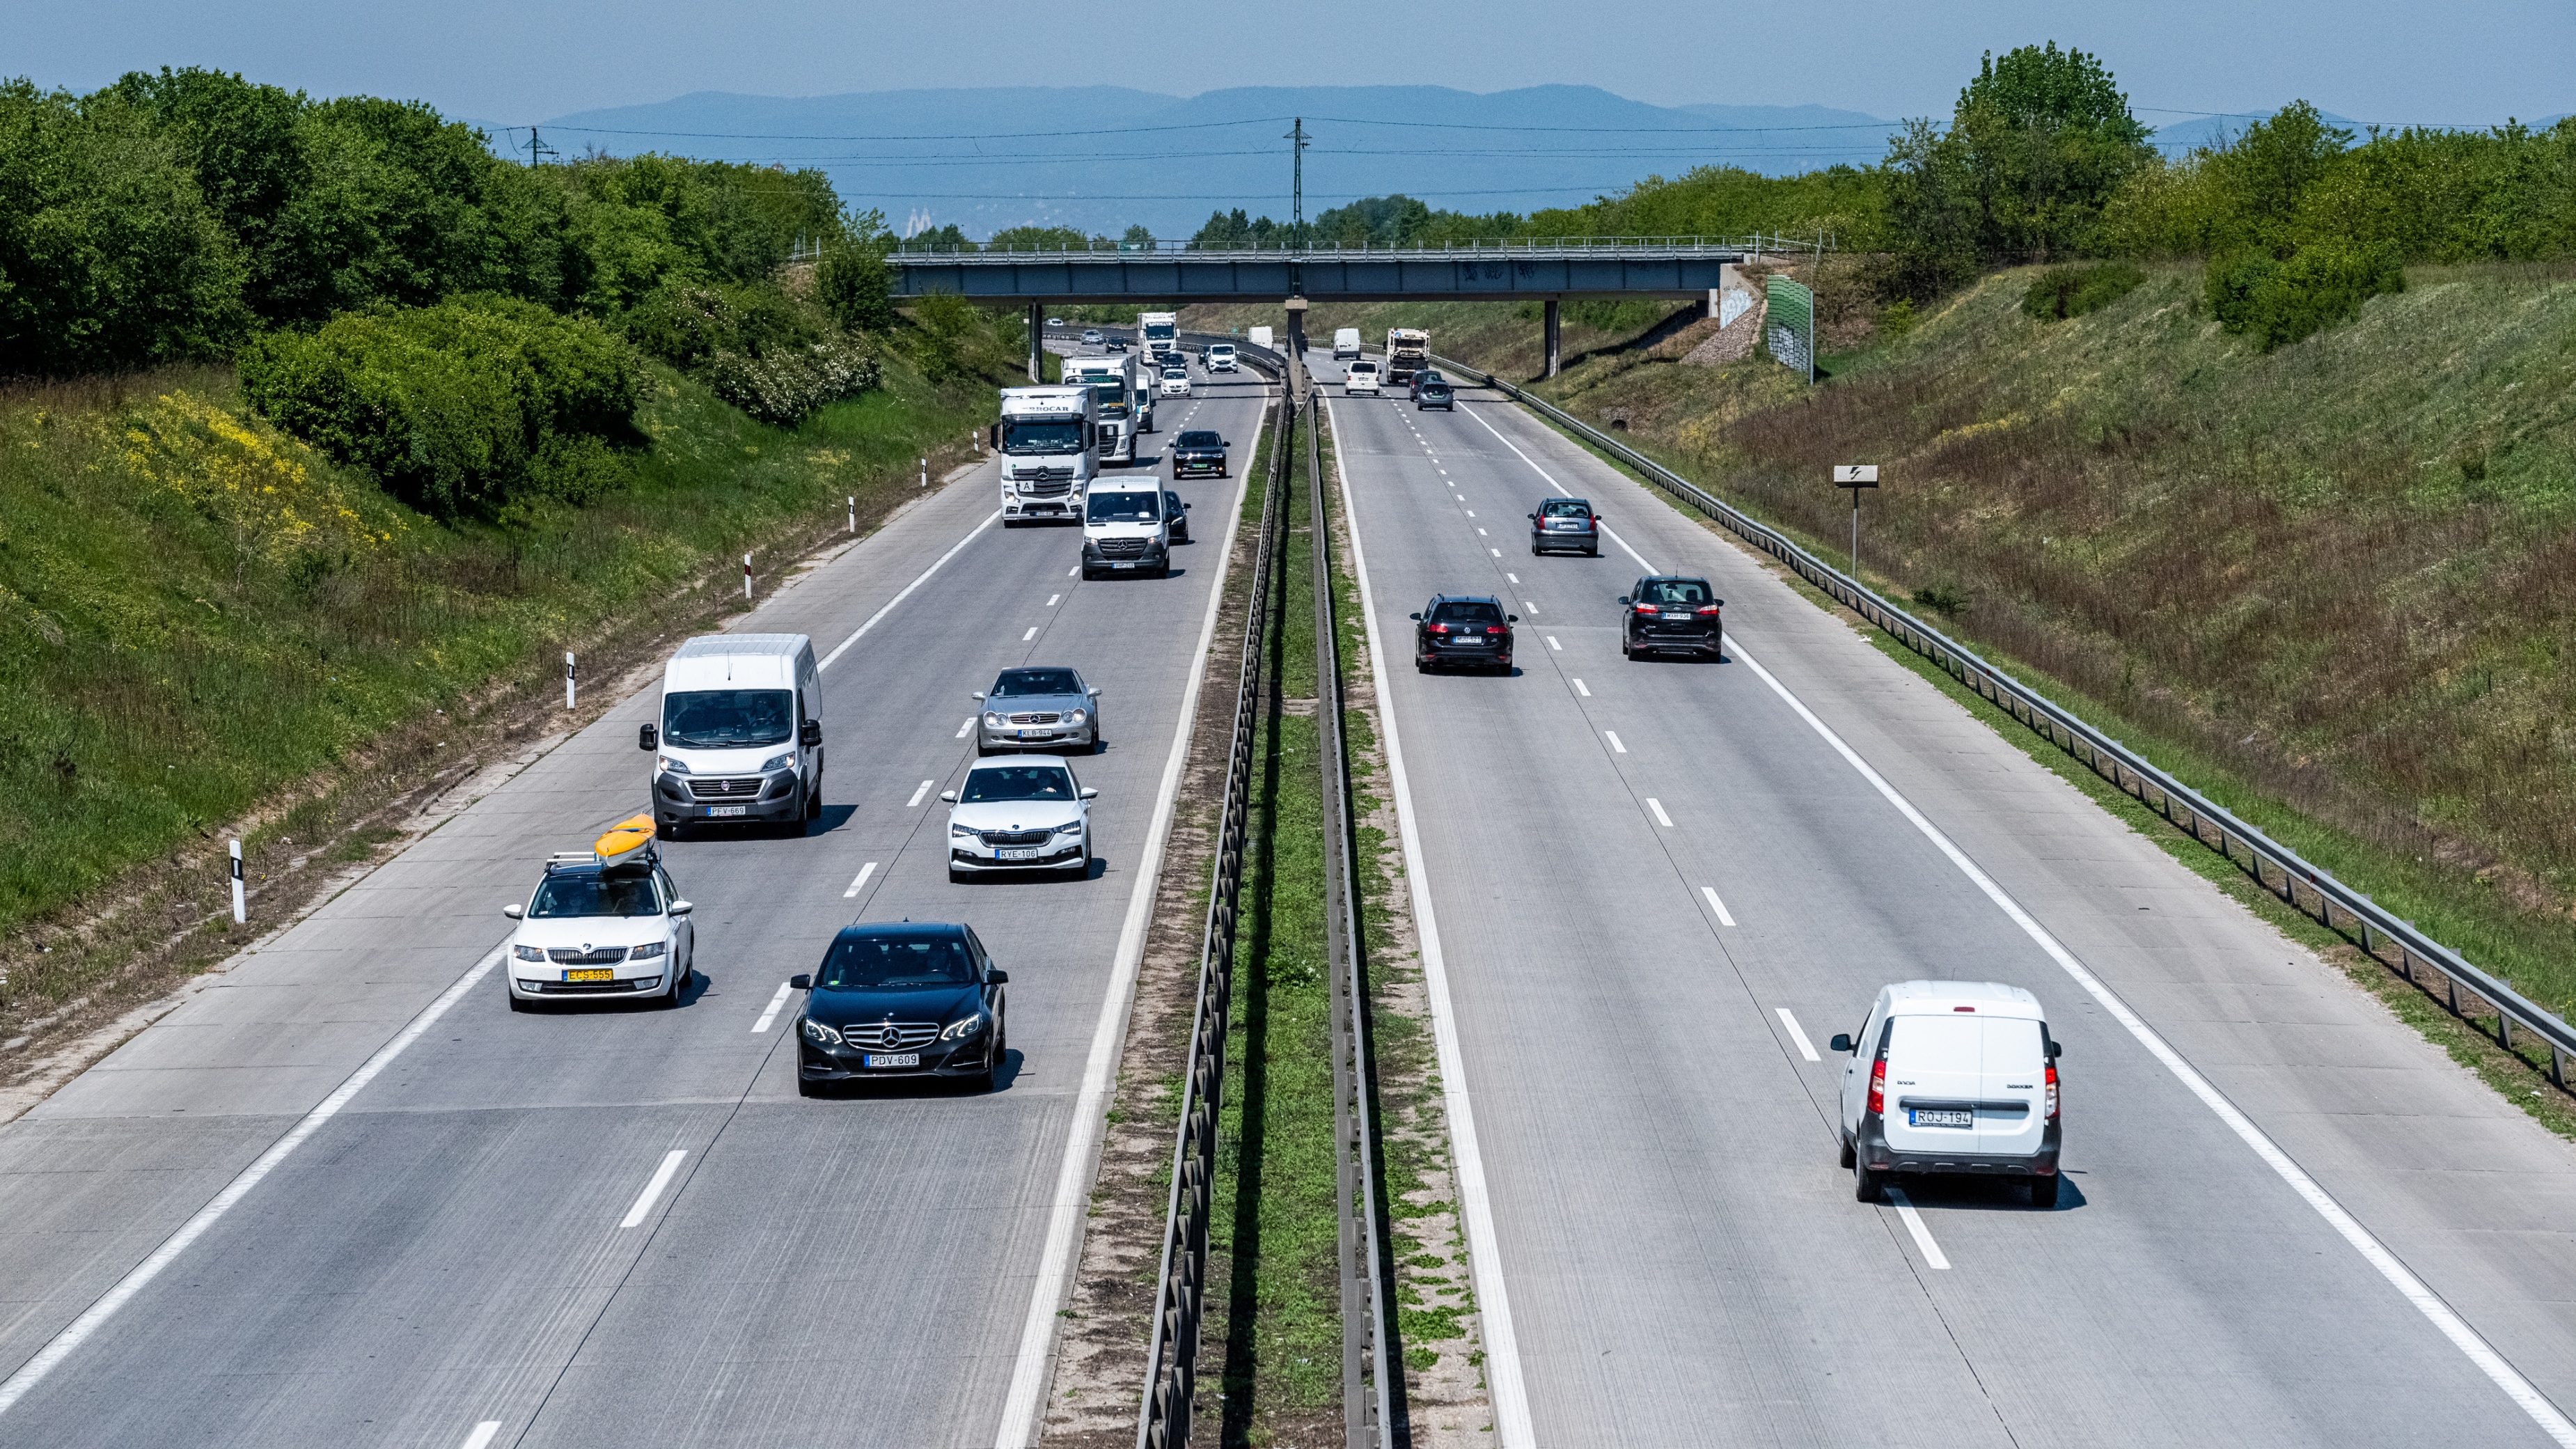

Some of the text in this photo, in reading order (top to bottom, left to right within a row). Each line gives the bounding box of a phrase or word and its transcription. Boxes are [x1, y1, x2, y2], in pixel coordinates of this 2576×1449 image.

[1023, 482, 1030, 490] A
[569, 971, 611, 980] ECS-555
[871, 1055, 917, 1065] PDV-609
[1918, 1111, 1968, 1123] ROJ-194
